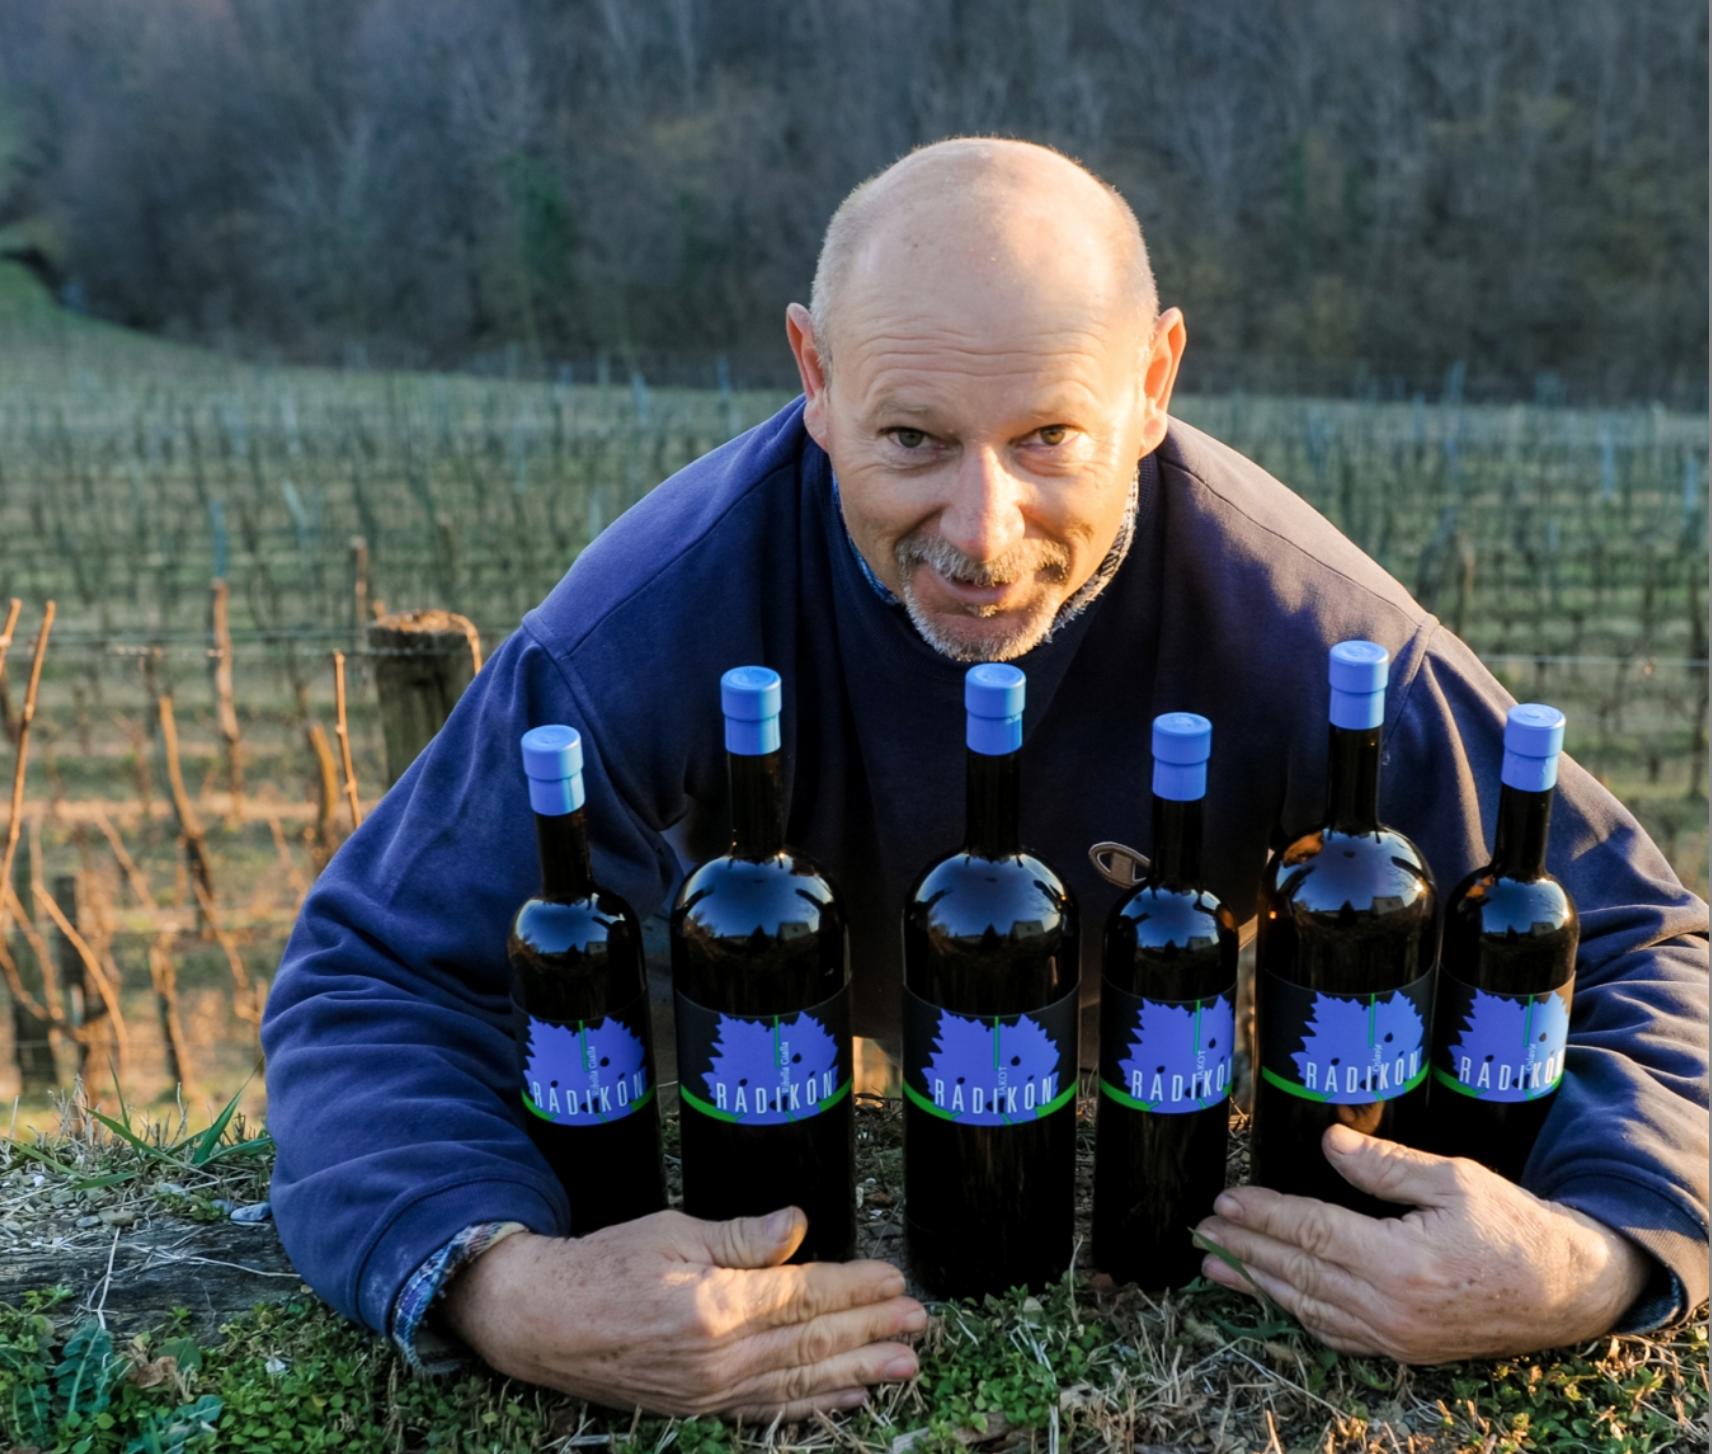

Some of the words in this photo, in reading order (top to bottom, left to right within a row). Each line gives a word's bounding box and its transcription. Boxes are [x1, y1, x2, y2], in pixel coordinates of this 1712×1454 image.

[588, 1046, 596, 1068] Gialla
[779, 1041, 789, 1063] Gialla
[1305, 1051, 1418, 1094] RADIKON
[532, 1073, 645, 1116] RADIKON
[715, 1069, 833, 1115] RADIKON
[934, 1076, 1053, 1115] RADIKON
